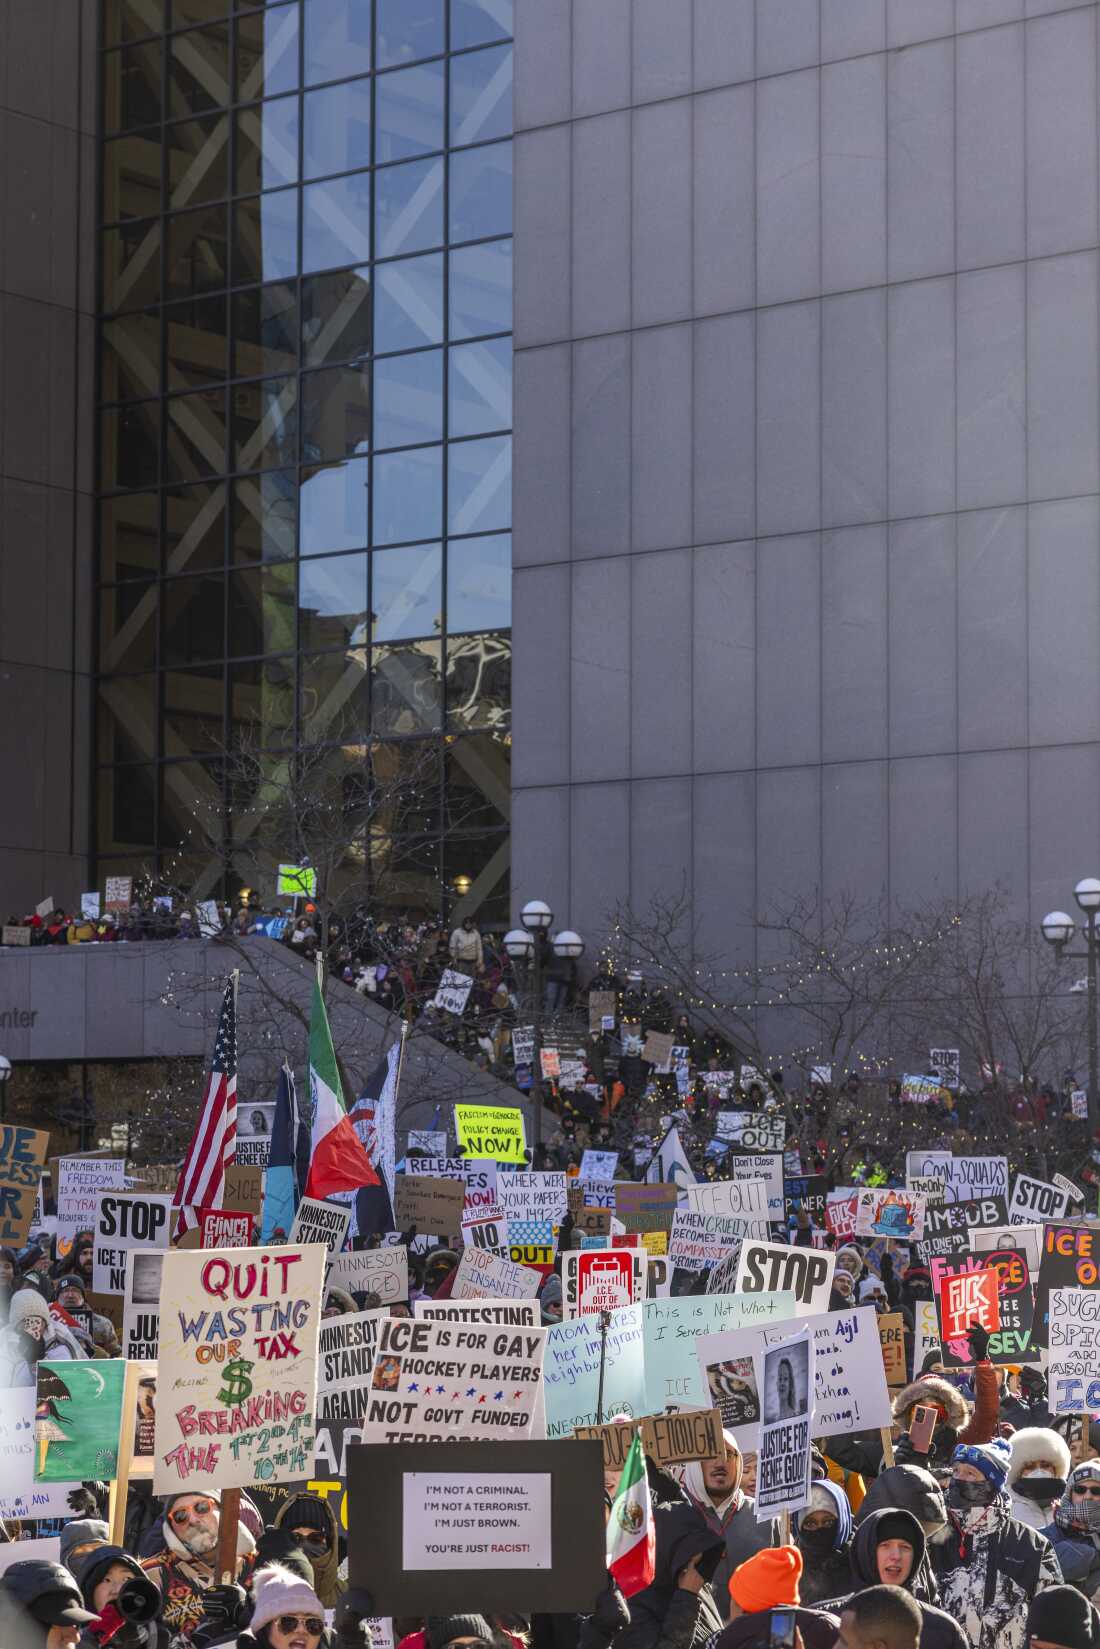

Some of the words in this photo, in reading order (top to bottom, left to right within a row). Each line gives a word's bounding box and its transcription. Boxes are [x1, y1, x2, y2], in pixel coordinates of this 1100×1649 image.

[742, 1131, 783, 1148] OUT
[60, 1161, 101, 1172] REMEMBER
[411, 1159, 472, 1173] RELEASE
[754, 1157, 775, 1167] Close
[67, 1173, 114, 1185] FREEDOM
[463, 1187, 495, 1209] NOW!
[500, 1192, 530, 1207] YOUR
[533, 1190, 567, 1207] PAPERS
[729, 1182, 764, 1214] OUT
[785, 1195, 825, 1212] PWER
[1016, 1180, 1065, 1217] STOP
[100, 1197, 166, 1241] STOP
[299, 1203, 346, 1232] MINNESOTA
[526, 1207, 562, 1221] 1492?
[675, 1212, 705, 1228] WHEN
[296, 1224, 338, 1253] STANDS
[472, 1222, 499, 1249] NO
[672, 1229, 716, 1244] BECOMES
[1046, 1227, 1093, 1257] ICE
[98, 1248, 115, 1266] ICE
[464, 1248, 494, 1270] STOP
[510, 1246, 552, 1263] OUT
[742, 1247, 829, 1305] STOP
[592, 1296, 607, 1305] OUT
[609, 1295, 619, 1304] OF
[949, 1274, 990, 1313] FUCK
[423, 1306, 533, 1327] PROTESTING
[645, 1302, 680, 1320] This
[693, 1304, 704, 1317] is
[714, 1303, 734, 1317] Not
[741, 1299, 778, 1315] What
[1053, 1291, 1100, 1322] SUG
[130, 1314, 159, 1342] JU
[654, 1326, 668, 1341] I
[1051, 1322, 1100, 1347] SPI
[195, 1338, 242, 1365] OUR
[253, 1331, 303, 1361] TAX
[379, 1321, 431, 1353] ICE
[436, 1330, 451, 1346] IS
[456, 1332, 487, 1349] FOR
[493, 1333, 540, 1359] GAY
[553, 1347, 578, 1364] her
[402, 1358, 467, 1378] HOCKEY
[470, 1363, 540, 1383] PLAYERS
[1050, 1361, 1100, 1378] ABOL
[217, 1357, 255, 1409] $
[664, 1377, 692, 1397] ICE
[369, 1400, 418, 1425] NOT
[424, 1407, 463, 1425] GOVT
[472, 1410, 529, 1427] FUNDED
[760, 1428, 792, 1460] JUSTICE
[793, 1420, 808, 1454] FOR
[162, 1442, 221, 1480] THE
[760, 1457, 785, 1490] RENEE
[426, 1486, 442, 1495] I'M
[443, 1486, 465, 1495] NOT
[467, 1486, 474, 1495] A
[475, 1485, 529, 1496] CRIMINAL.
[424, 1503, 440, 1512] I'M
[441, 1502, 463, 1512] NOT
[464, 1503, 472, 1512] A
[474, 1502, 532, 1512] TERRORIST.
[434, 1519, 450, 1528] I'M
[452, 1519, 476, 1529] JUST
[478, 1519, 521, 1529] BROWN.
[425, 1543, 463, 1554] YOU'RE
[465, 1544, 489, 1554] JUST
[491, 1543, 530, 1554] RACIST!
